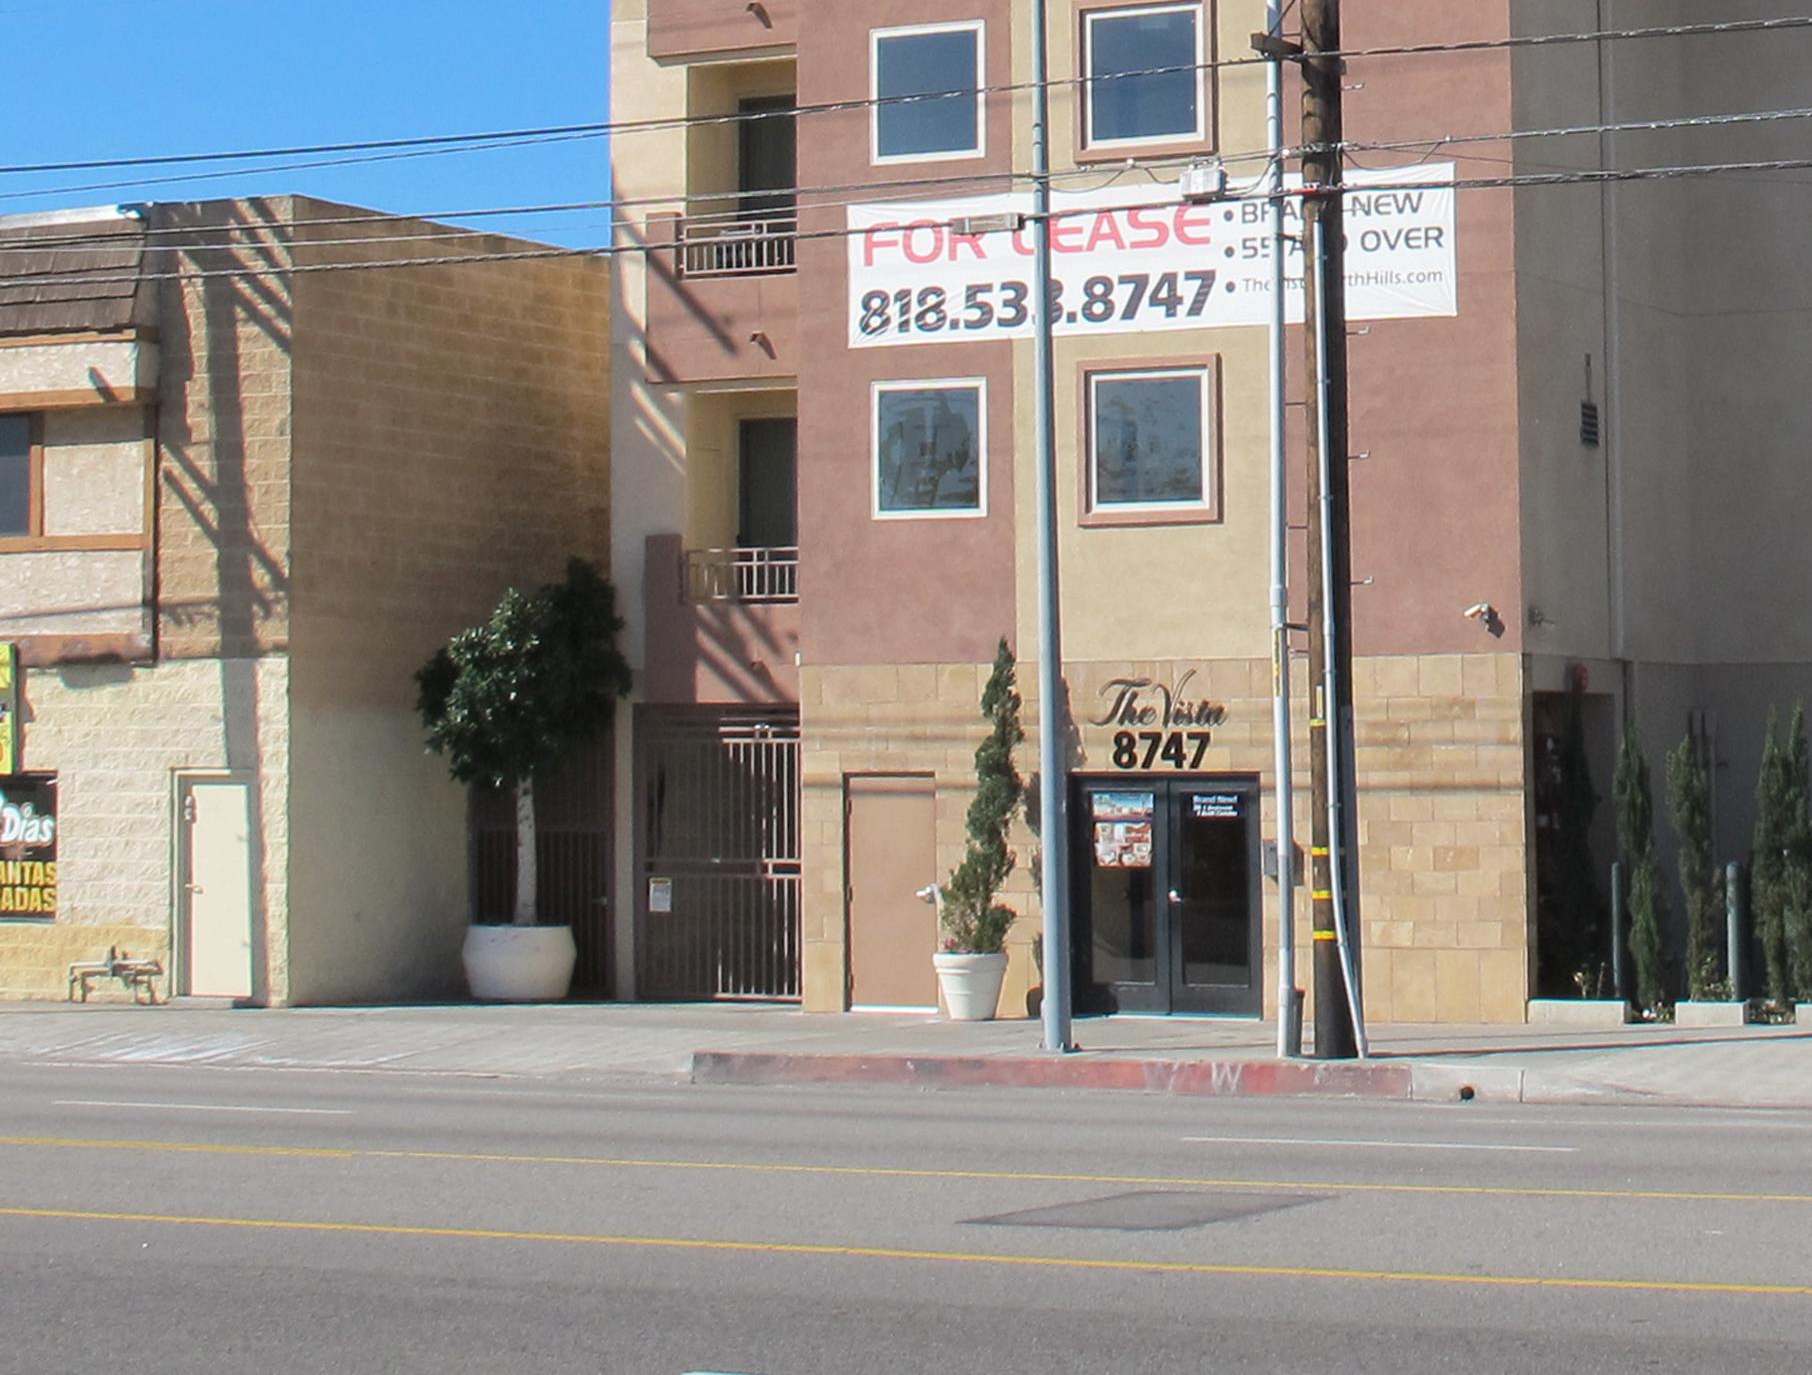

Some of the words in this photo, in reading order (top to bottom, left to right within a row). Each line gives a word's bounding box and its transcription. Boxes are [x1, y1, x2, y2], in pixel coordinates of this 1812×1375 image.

[1352, 192, 1424, 217] NEW
[864, 219, 987, 267] FOR
[1360, 226, 1444, 253] OVER
[1088, 678, 1157, 726] The
[1152, 668, 1228, 728] Vista
[1113, 730, 1211, 769] 8747
